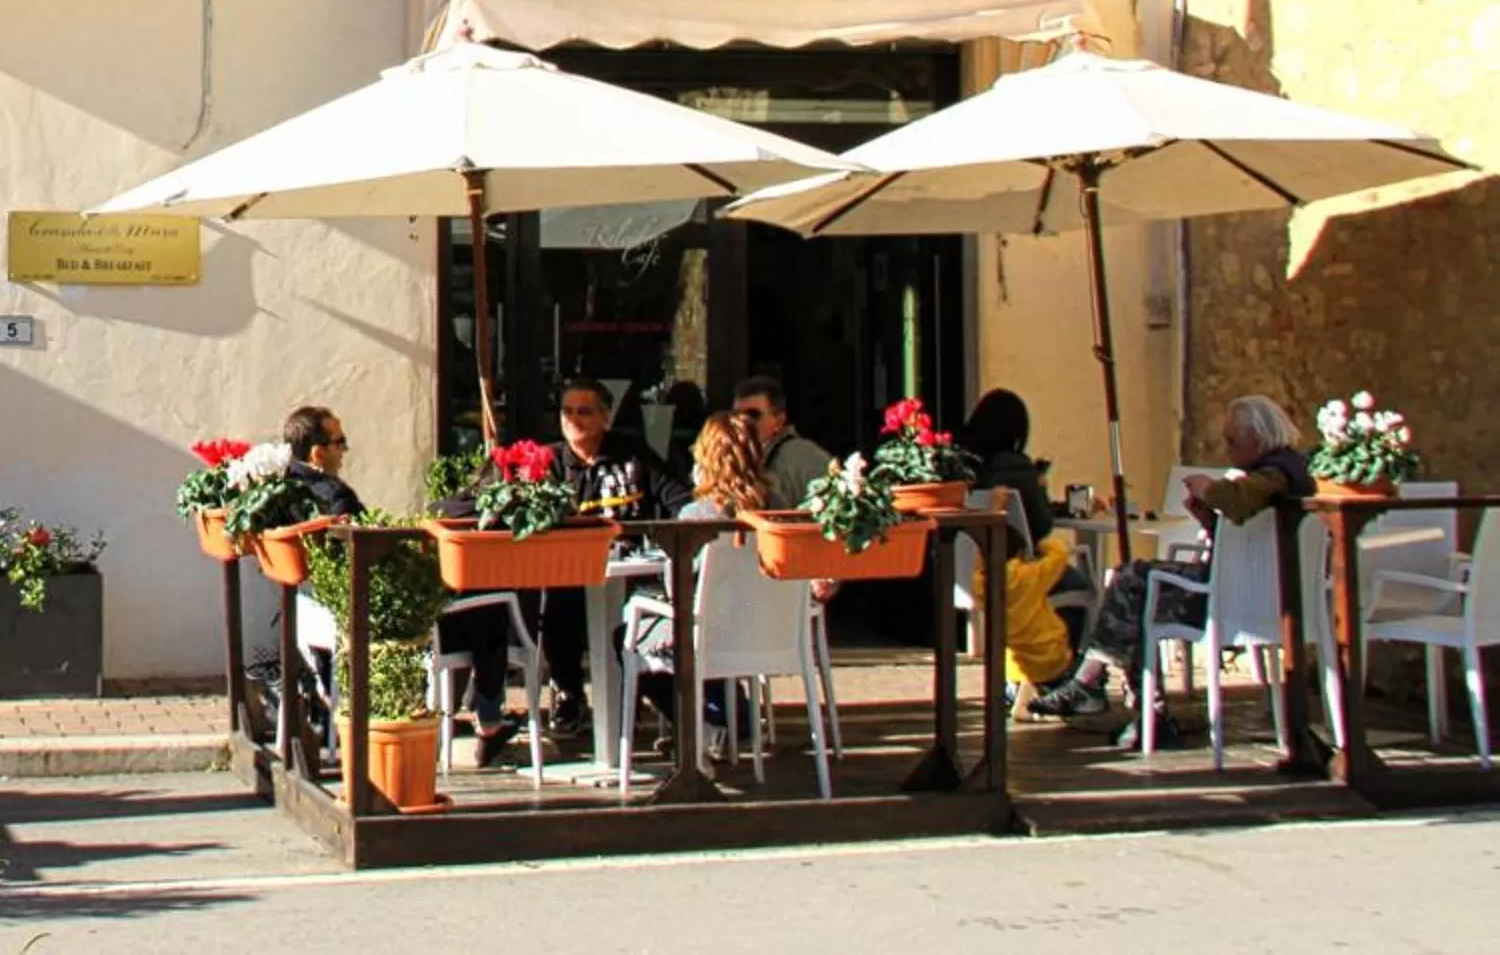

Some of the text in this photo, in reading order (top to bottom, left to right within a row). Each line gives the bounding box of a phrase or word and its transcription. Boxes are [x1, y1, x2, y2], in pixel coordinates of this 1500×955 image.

[56, 258, 153, 273] BED & BREAKFAST
[7, 321, 18, 338] 5
